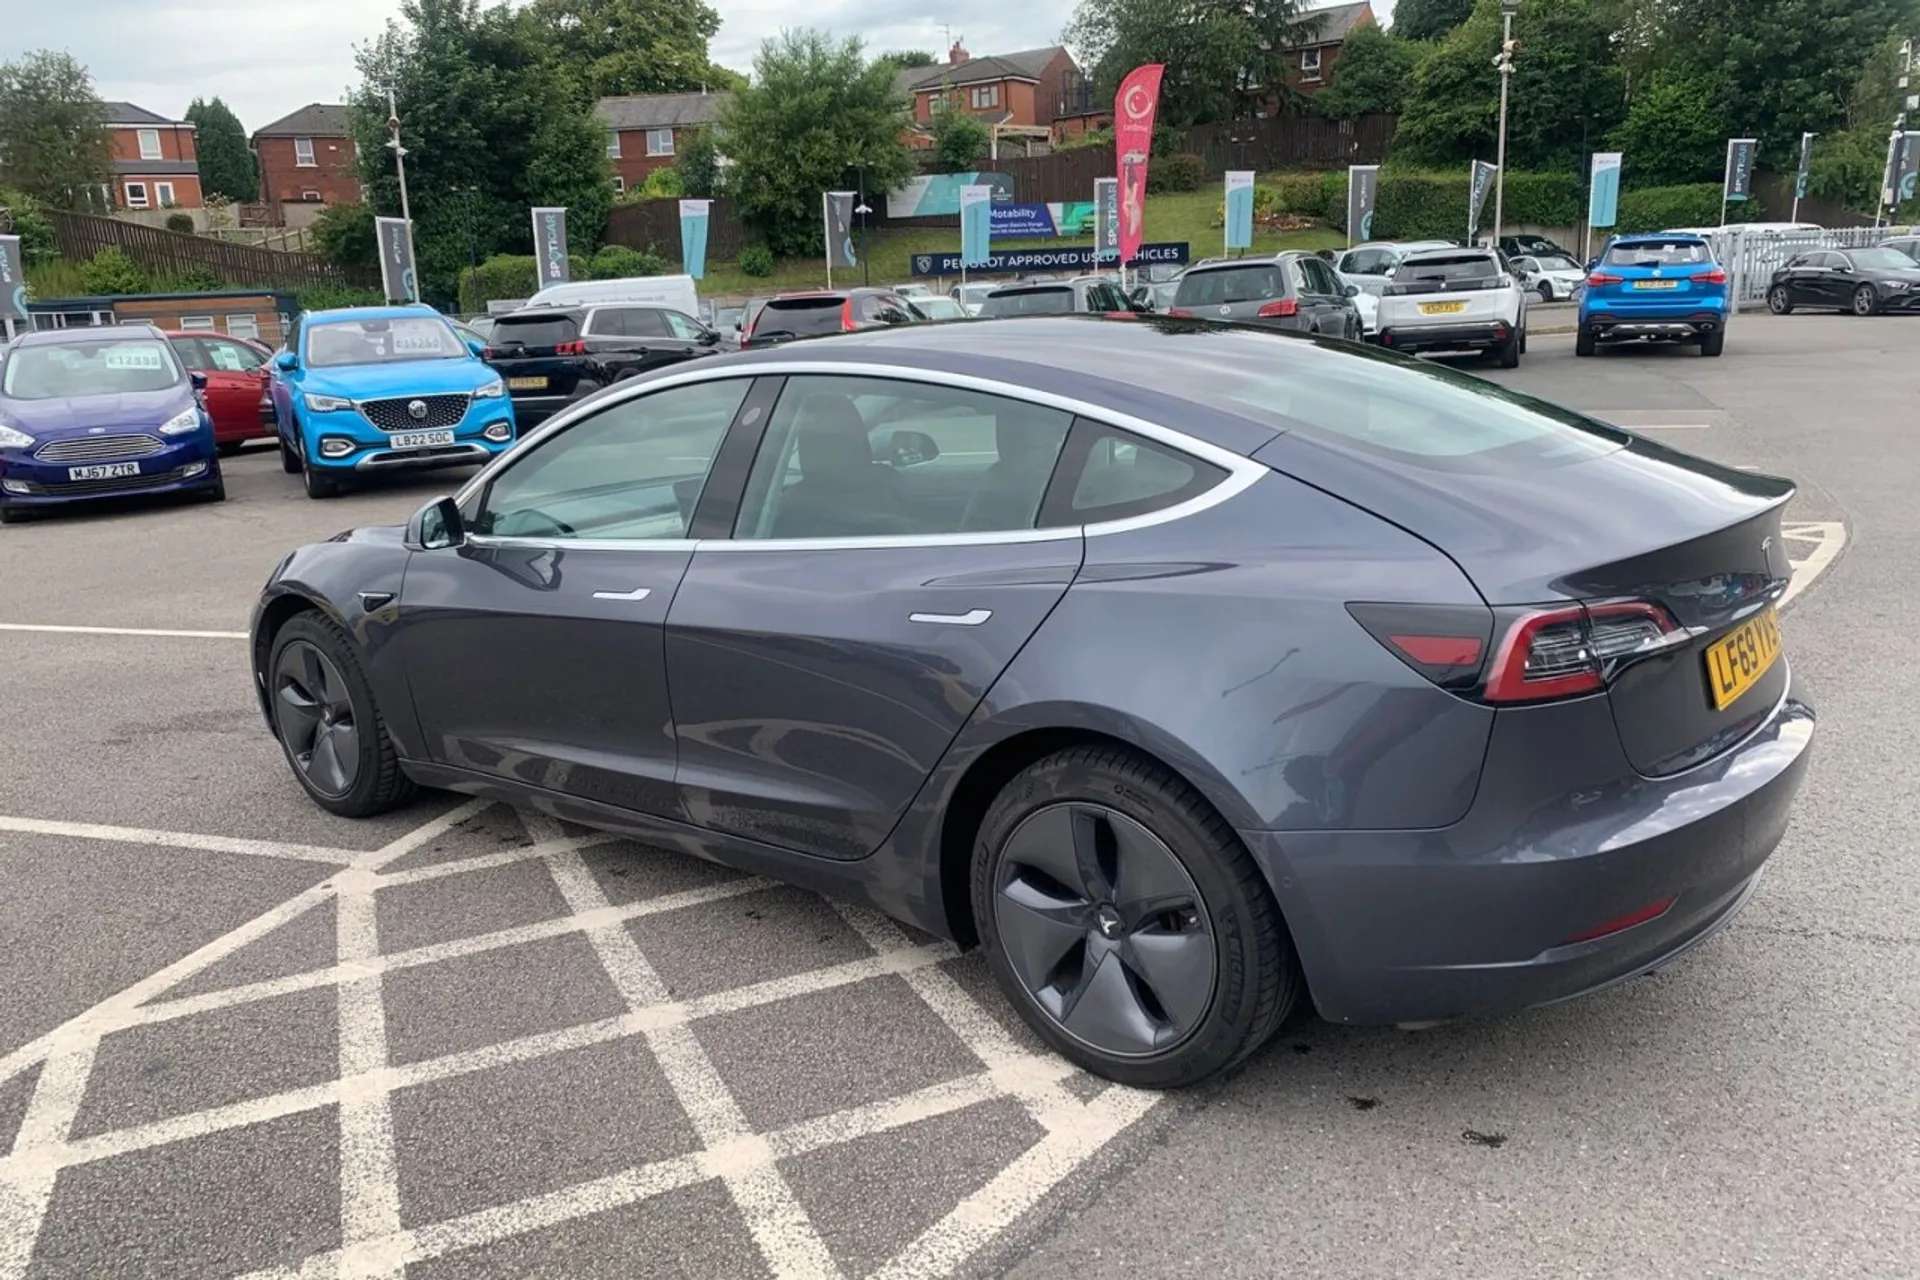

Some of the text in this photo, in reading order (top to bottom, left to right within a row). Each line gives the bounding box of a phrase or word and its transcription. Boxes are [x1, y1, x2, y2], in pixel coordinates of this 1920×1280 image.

[1734, 144, 1747, 192] SPOTICAR
[1107, 184, 1119, 246] SPOTICAR
[544, 214, 564, 279] SPOTICAR
[1008, 252, 1079, 267] APPROVED
[1134, 248, 1179, 261] HICLES
[396, 434, 426, 447] LB22
[1714, 626, 1759, 694] LF69
